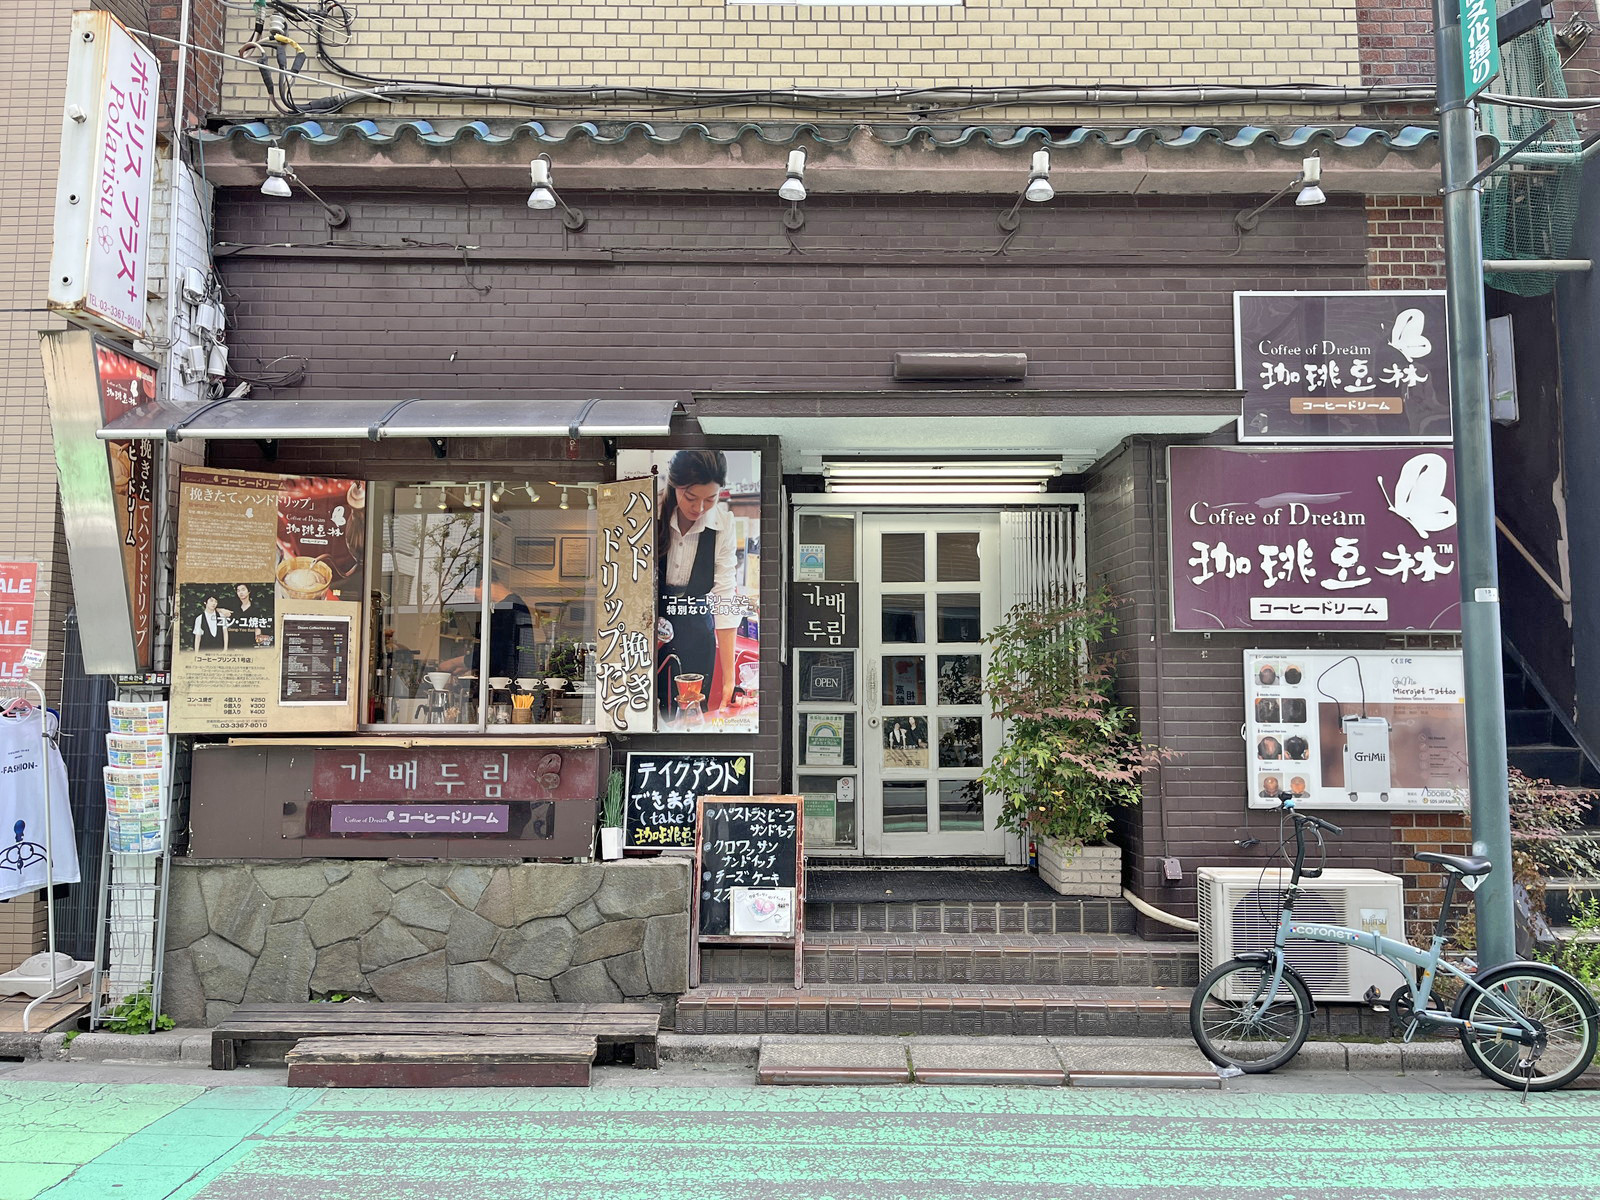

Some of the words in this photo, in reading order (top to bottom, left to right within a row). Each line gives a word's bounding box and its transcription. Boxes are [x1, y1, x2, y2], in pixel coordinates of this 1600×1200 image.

[1464, 0, 1492, 84] 文化通り
[123, 51, 150, 179] ポラリス
[100, 80, 126, 220] Polarisu
[88, 292, 99, 308] TEL
[99, 300, 142, 330] 03-3367-8010
[1258, 340, 1301, 356] Coffee
[1305, 341, 1318, 356] of
[1322, 340, 1371, 356] Dream
[1259, 358, 1429, 393] 珈琲豆林
[1302, 400, 1390, 411] コーヒードリーム
[220, 477, 287, 490] コーヒードリーム
[1188, 501, 1257, 527] Coffee
[1262, 507, 1283, 527] of
[1288, 501, 1366, 527] Dream
[623, 491, 651, 582] ハンド
[1187, 537, 1455, 591] 珈琲豆林
[598, 524, 625, 662] ドリップ
[802, 585, 845, 613] 가배
[1258, 601, 1379, 616] コーヒードリーム
[803, 613, 846, 645] 두림
[619, 630, 651, 710] 挽き
[814, 677, 839, 688] OPEN
[597, 663, 629, 730] たて
[1392, 687, 1426, 697] Microjet
[1429, 687, 1456, 695] Tattoo
[1354, 751, 1386, 762] GriMii
[637, 759, 739, 792] テイクアウト
[631, 790, 696, 815] できます
[344, 815, 361, 824] Coffee
[361, 816, 367, 824] of
[368, 816, 387, 824] Dream
[398, 810, 499, 824] コーヒードリーム
[715, 807, 795, 825] パストラミビーフ
[750, 823, 796, 839] サンドイッチ
[713, 839, 778, 857] クロワッサン
[722, 855, 777, 869] サンドイッチ
[1361, 918, 1387, 926] FUJITSU
